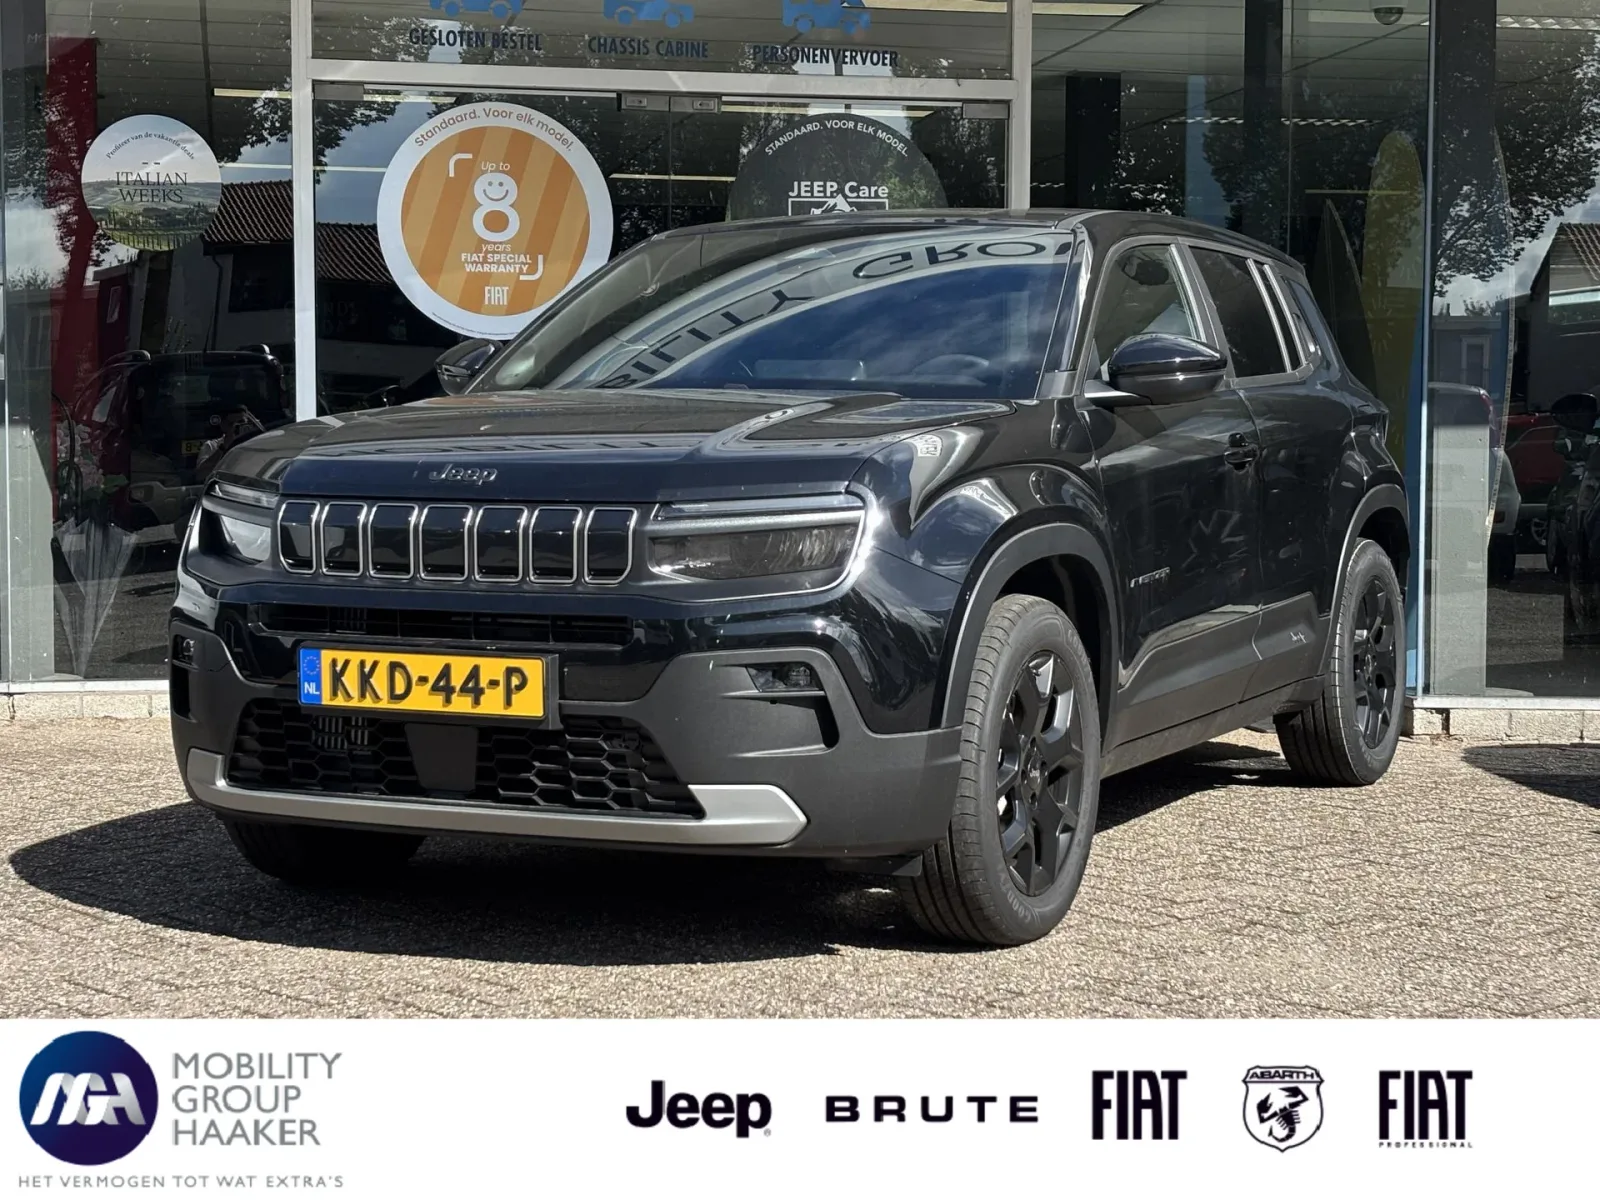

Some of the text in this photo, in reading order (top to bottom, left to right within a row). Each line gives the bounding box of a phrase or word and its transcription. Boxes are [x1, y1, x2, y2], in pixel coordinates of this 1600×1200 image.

[409, 28, 543, 51] GESLOTEN BESTEL
[588, 37, 709, 58] CHASSIS CABINE
[752, 44, 898, 67] PERSONENVERVOER
[414, 107, 574, 152] Standaard. Voor elk model.
[765, 119, 908, 157] STANDAARD. VOOR ELK MODEL.
[105, 138, 130, 159] Profiteer
[131, 133, 143, 141] van
[153, 132, 181, 147] vakantie
[180, 144, 195, 160] deals
[481, 162, 511, 172] Up to
[115, 171, 188, 186] ITALIAN
[119, 188, 183, 203] WEEKS
[844, 181, 889, 198] Care
[472, 172, 521, 242] 8
[461, 253, 532, 264] FIAT SPECIAL
[481, 243, 512, 254] years
[464, 263, 529, 274] WARRANTY
[484, 286, 510, 306] FIAT
[428, 463, 498, 486] Jeep
[303, 681, 320, 695] NL
[329, 657, 529, 710] KKD-44-P
